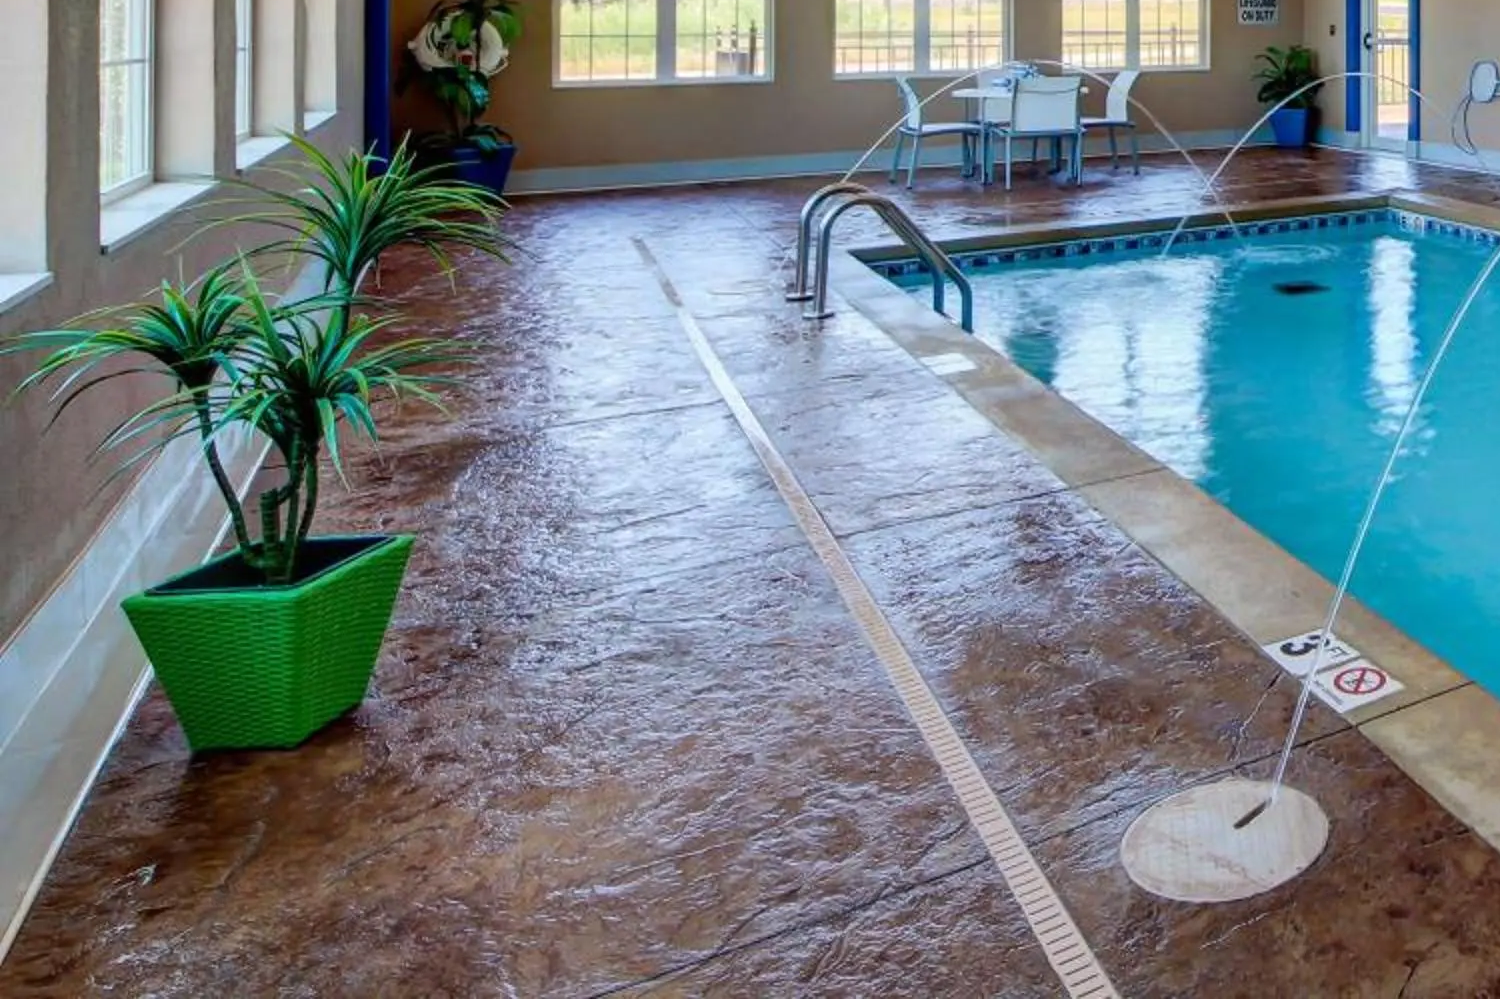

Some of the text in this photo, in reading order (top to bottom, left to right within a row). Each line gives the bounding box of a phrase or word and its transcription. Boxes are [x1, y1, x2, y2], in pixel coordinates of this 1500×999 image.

[1242, 10, 1274, 21] ON DUTY
[1280, 634, 1331, 656] 3
